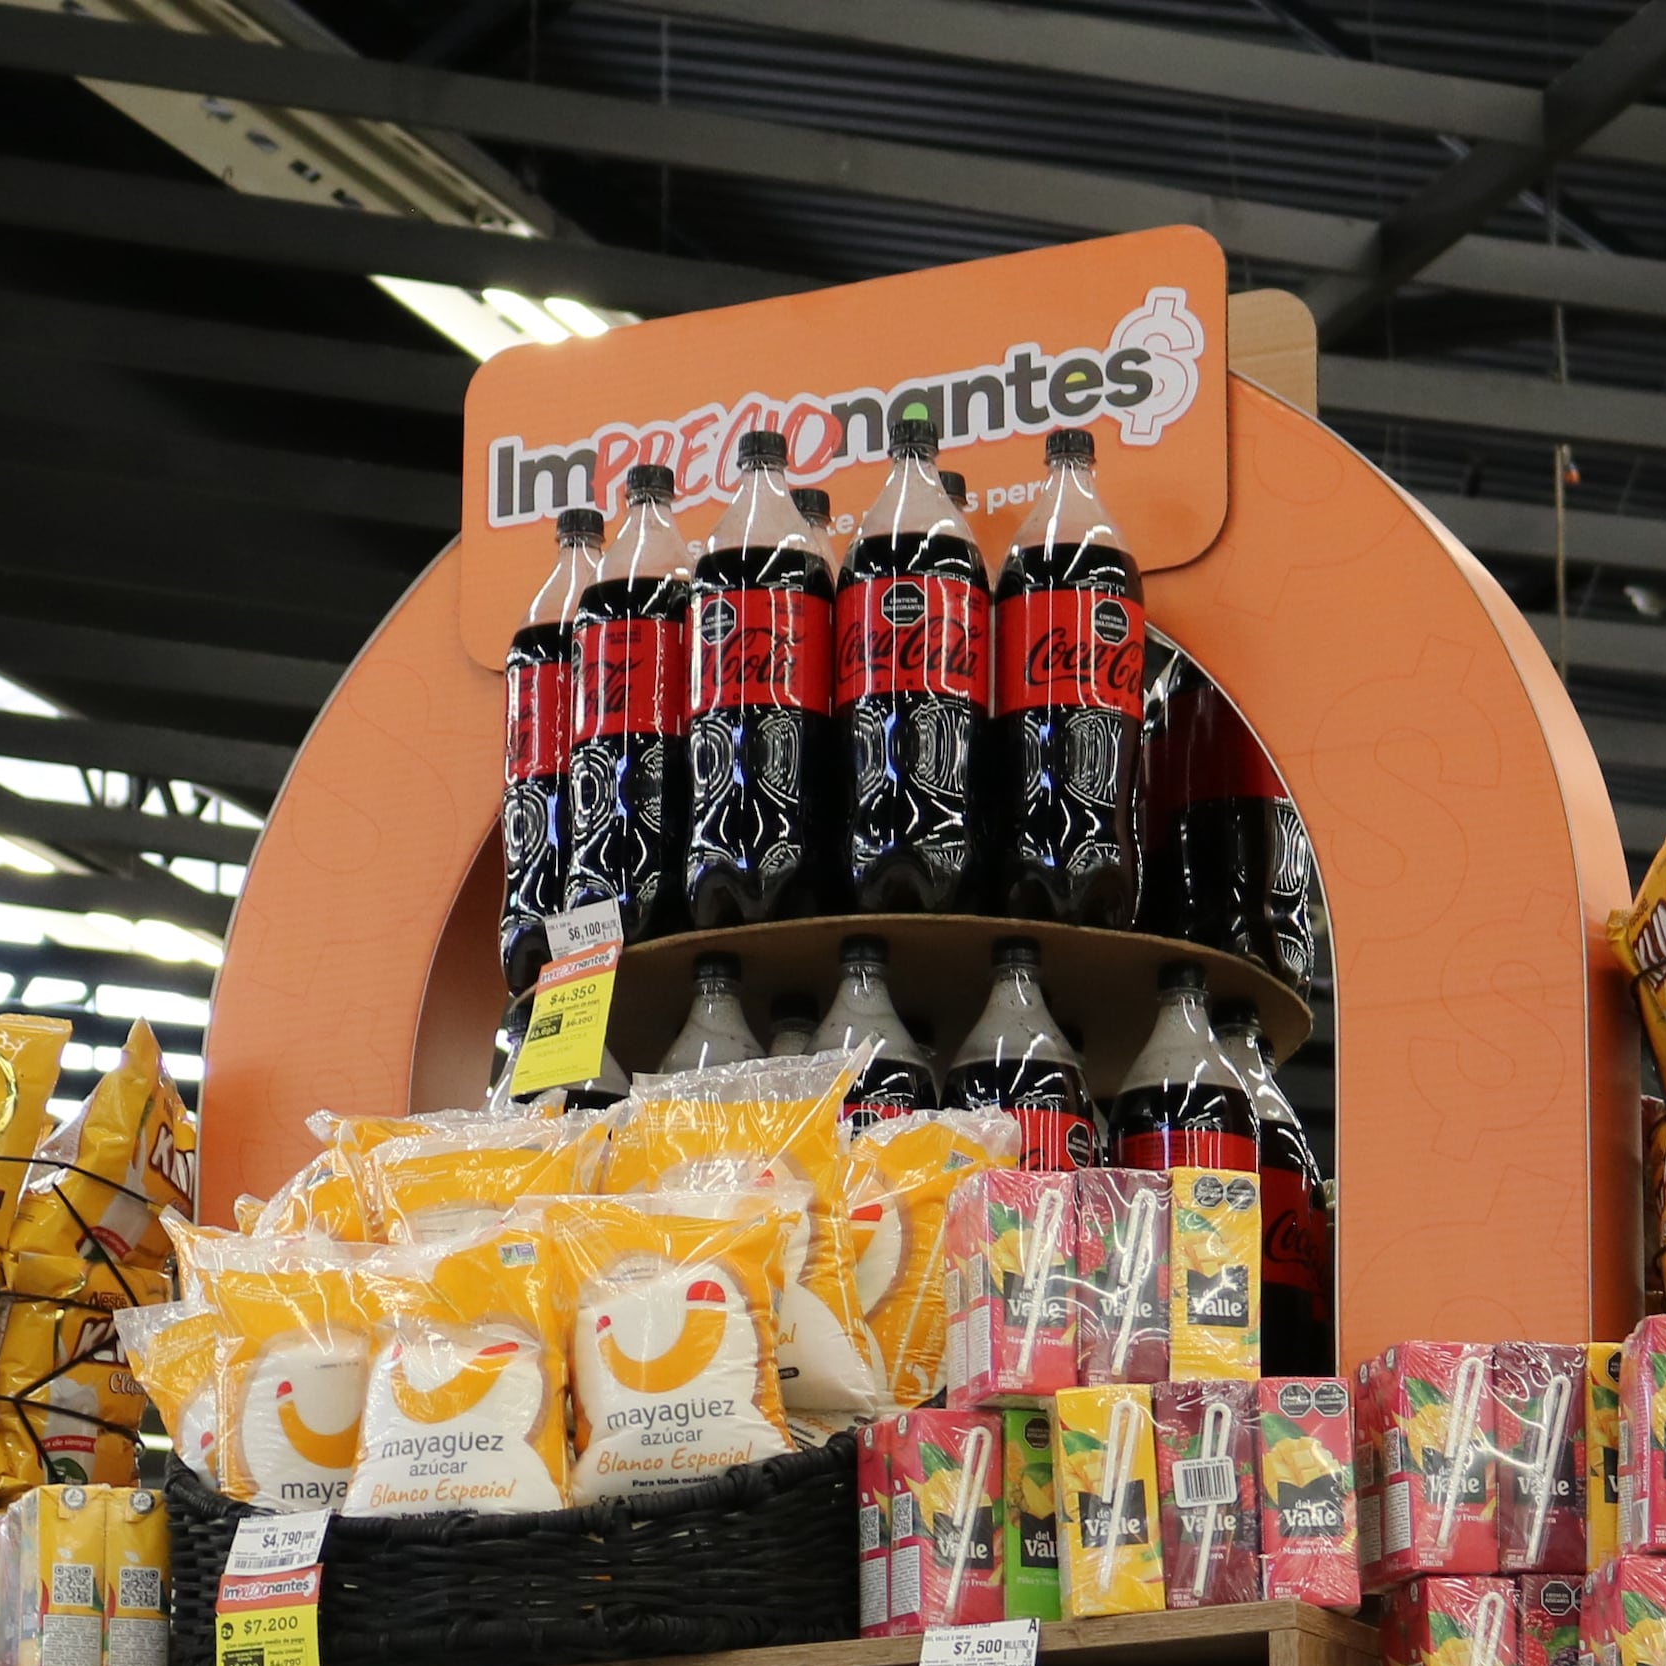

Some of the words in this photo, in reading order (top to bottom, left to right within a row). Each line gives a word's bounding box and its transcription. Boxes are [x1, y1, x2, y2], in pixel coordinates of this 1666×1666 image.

[569, 921, 601, 941] $6,100
[641, 1427, 703, 1446] azúcar
[597, 1451, 663, 1475] Blanco
[671, 1441, 753, 1470] Especial
[262, 1531, 301, 1549] $4,790
[244, 1616, 298, 1635] $7.200
[954, 1639, 1002, 1655] $7,500
